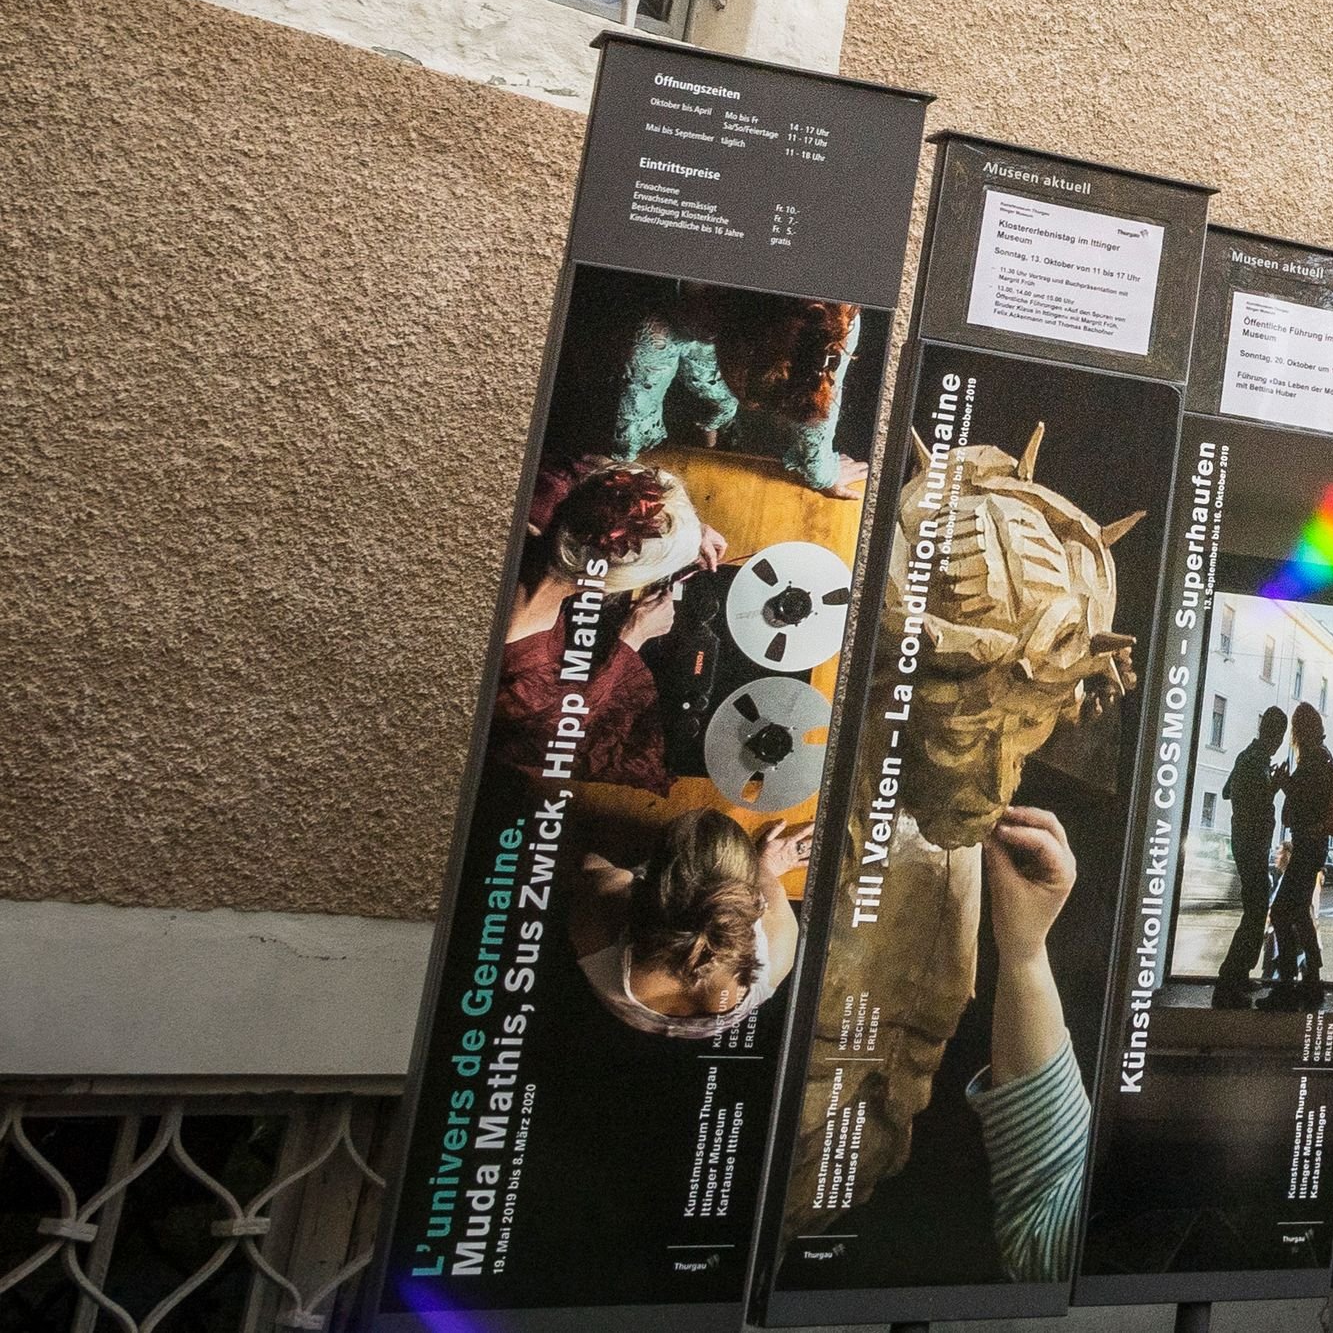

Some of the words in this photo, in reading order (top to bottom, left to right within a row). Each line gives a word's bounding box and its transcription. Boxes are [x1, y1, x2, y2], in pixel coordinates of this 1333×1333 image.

[654, 72, 741, 100] Öffnungszeiten
[650, 97, 681, 110] Oktober
[681, 102, 694, 113] bis
[693, 105, 713, 116] April
[724, 111, 738, 121] Mo
[738, 113, 750, 123] bis
[751, 115, 759, 124] Fr
[645, 122, 661, 133] Mai
[661, 125, 674, 135] bis
[674, 127, 715, 142] September
[720, 136, 746, 148] täglich
[788, 133, 797, 142] 11
[804, 136, 814, 145] 17
[814, 138, 828, 148] Uhr
[789, 122, 799, 132] 14
[805, 125, 815, 134] 17
[815, 127, 830, 137] Uhr
[639, 156, 721, 181] Eintrittspreise
[785, 147, 795, 157] 11
[801, 150, 811, 160] 18
[811, 152, 826, 162] Uhr
[635, 180, 680, 196] Erwachsene
[982, 161, 1039, 184] Museen
[1041, 175, 1091, 195] aktuell
[996, 230, 1033, 245] Museum
[998, 219, 1076, 245] Klostererlebnistag
[1077, 236, 1089, 245] im
[1090, 238, 1121, 252] Ittinger
[1231, 249, 1279, 270] Museen
[1281, 261, 1329, 281] aktuell
[1241, 328, 1275, 341] Museum
[918, 373, 961, 510] humaine
[1220, 446, 1230, 469] 2019
[1215, 474, 1227, 508] Oktober
[1212, 525, 1221, 539] bis
[1214, 510, 1222, 523] 16.
[1205, 540, 1219, 596] September
[899, 520, 938, 673] condition
[1203, 596, 1212, 610] 13.
[555, 560, 607, 680] Mathis
[885, 684, 913, 720] La
[538, 685, 591, 777] Hipp
[1120, 819, 1172, 1093] Künstlerkollektiv
[1154, 665, 1190, 809] COSMOS
[1175, 442, 1216, 629] Superhaufen
[863, 757, 902, 867] Velten
[515, 790, 573, 909] Zwick,
[461, 818, 526, 1016] Germaine.
[852, 876, 884, 927] Till
[501, 921, 544, 991] Sus
[843, 993, 856, 1017] UND
[852, 991, 869, 1051] GESCHICHTE
[838, 1018, 851, 1051] KUNST
[866, 1007, 881, 1051] ERLEBEN
[451, 1029, 486, 1077] de
[473, 1004, 535, 1147] Mathis,
[521, 1083, 537, 1114] 2020
[514, 1117, 531, 1151] März
[683, 1122, 709, 1217] Kunstmuseum
[698, 1066, 718, 1120] Thurgau
[708, 1108, 727, 1164] Museum
[725, 1102, 744, 1153] Ittingen
[812, 1119, 835, 1209] Kunstmuseum
[826, 1068, 844, 1118] Thurgau
[834, 1107, 852, 1160] Museum
[849, 1101, 867, 1149] Ittingen
[512, 1153, 524, 1165] 8.
[507, 1169, 522, 1190] bis
[699, 1167, 718, 1217] Ittinger
[716, 1156, 736, 1216] Kartause
[826, 1163, 843, 1209] Ittinger
[841, 1152, 859, 1208] Kartause
[451, 1165, 501, 1275] Muda
[501, 1193, 517, 1224] 2019
[495, 1227, 511, 1253] Mai
[804, 1250, 833, 1260] Thurgau
[492, 1256, 506, 1274] 19.
[674, 1262, 707, 1272] Thurgau
